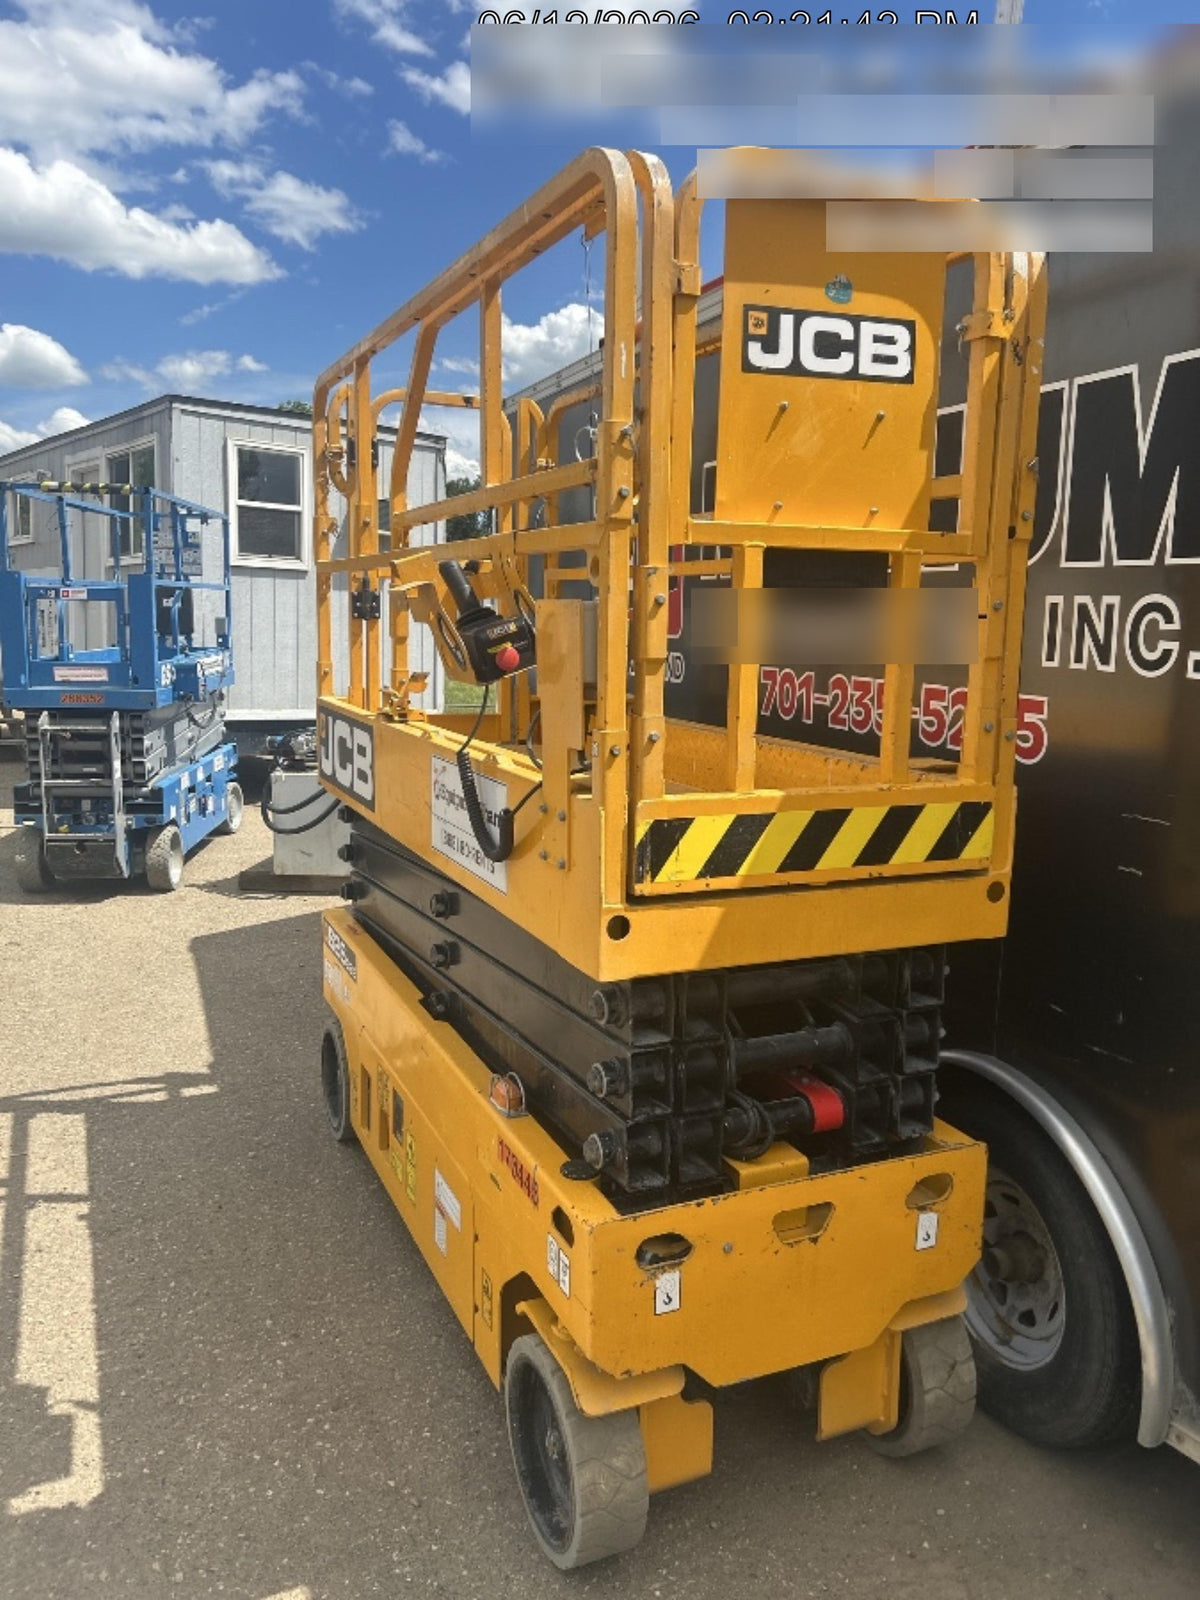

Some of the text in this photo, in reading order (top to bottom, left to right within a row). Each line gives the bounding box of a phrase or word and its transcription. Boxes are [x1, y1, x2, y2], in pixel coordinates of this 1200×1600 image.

[748, 313, 912, 378] JCB
[1041, 592, 1200, 680] INC.
[320, 715, 374, 800] JCB
[760, 666, 1048, 765] 701-23-525
